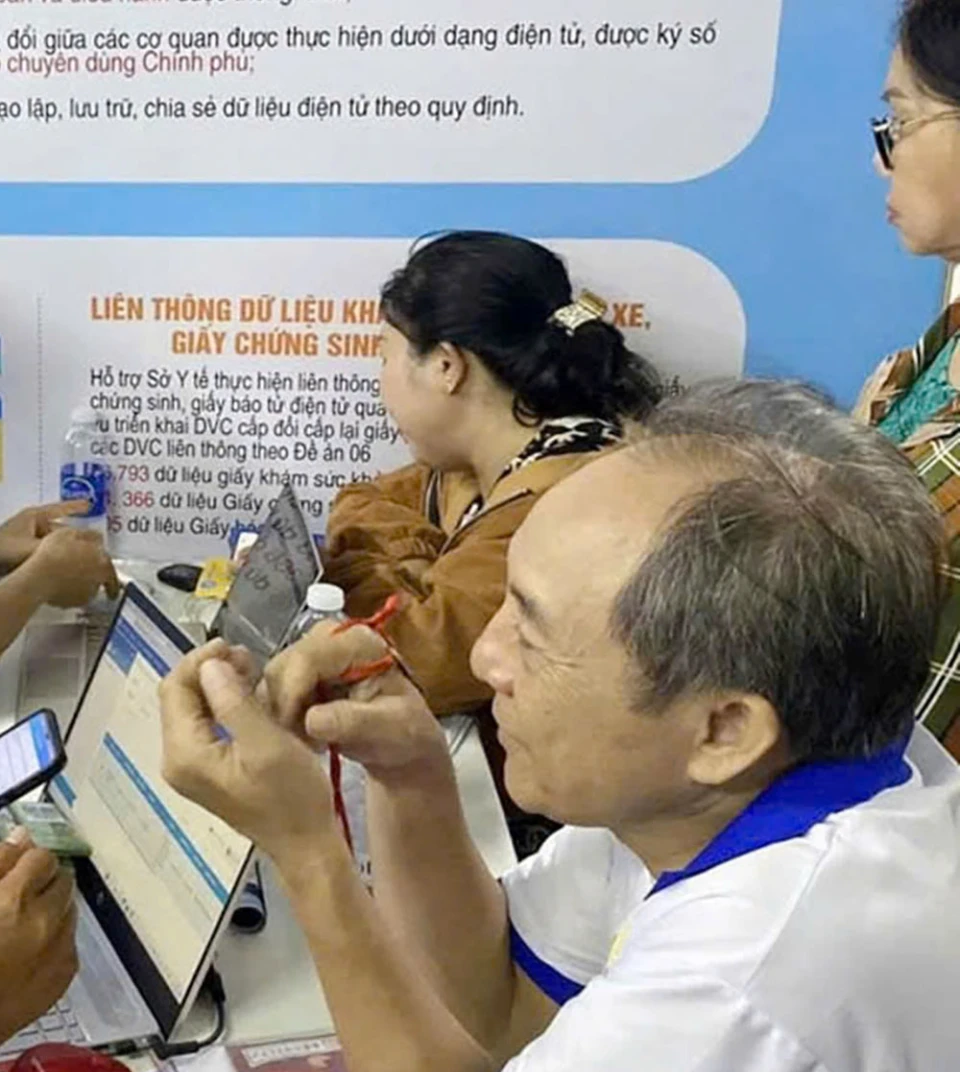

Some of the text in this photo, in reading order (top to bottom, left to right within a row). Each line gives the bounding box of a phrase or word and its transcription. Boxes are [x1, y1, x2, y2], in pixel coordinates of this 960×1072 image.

[7, 24, 38, 50] đổi
[44, 29, 87, 54] giữa
[93, 29, 130, 50] các
[136, 31, 161, 50] cơ
[168, 31, 219, 52] quan
[227, 27, 279, 52] được
[286, 26, 331, 51] thực
[338, 25, 383, 49] hiện
[390, 24, 436, 48] dưới
[443, 24, 498, 51] dạng
[505, 23, 552, 49] điện
[594, 23, 649, 49] được
[656, 22, 683, 50] ký
[690, 19, 718, 46] số
[7, 52, 79, 78] chuyên
[85, 51, 136, 78] dùng
[142, 50, 203, 74] Chính
[27, 98, 63, 122] lập,
[70, 99, 99, 118] lưu
[144, 98, 187, 118] chia
[192, 94, 217, 118] sẻ
[222, 97, 251, 118] dữ
[254, 96, 291, 121] liệu
[297, 96, 342, 121] điện
[348, 93, 371, 118] tử
[374, 96, 423, 118] theo
[427, 98, 467, 122] quy
[473, 95, 525, 121] định.
[90, 292, 651, 330] LIÊN THÔNG DỮ LIỆU XE,
[172, 323, 227, 355] GIẤY
[234, 325, 319, 356] CHỨNG
[90, 365, 381, 398] Hỗ trợ Sở Y tế thực hiện liên thông
[90, 393, 350, 419] chứng sinh, giấy báo điện tử
[155, 415, 401, 445] khai DVC cấp cấp lại giấy
[124, 436, 371, 463] DVC liên thông theo Đề án 06
[155, 465, 345, 489] dữ liệu giấy sức
[123, 490, 155, 507] 366
[160, 489, 182, 508] dữ
[187, 492, 218, 512] liệu
[223, 491, 263, 516] Giấy
[128, 515, 231, 540] dữ liệu Giấy
